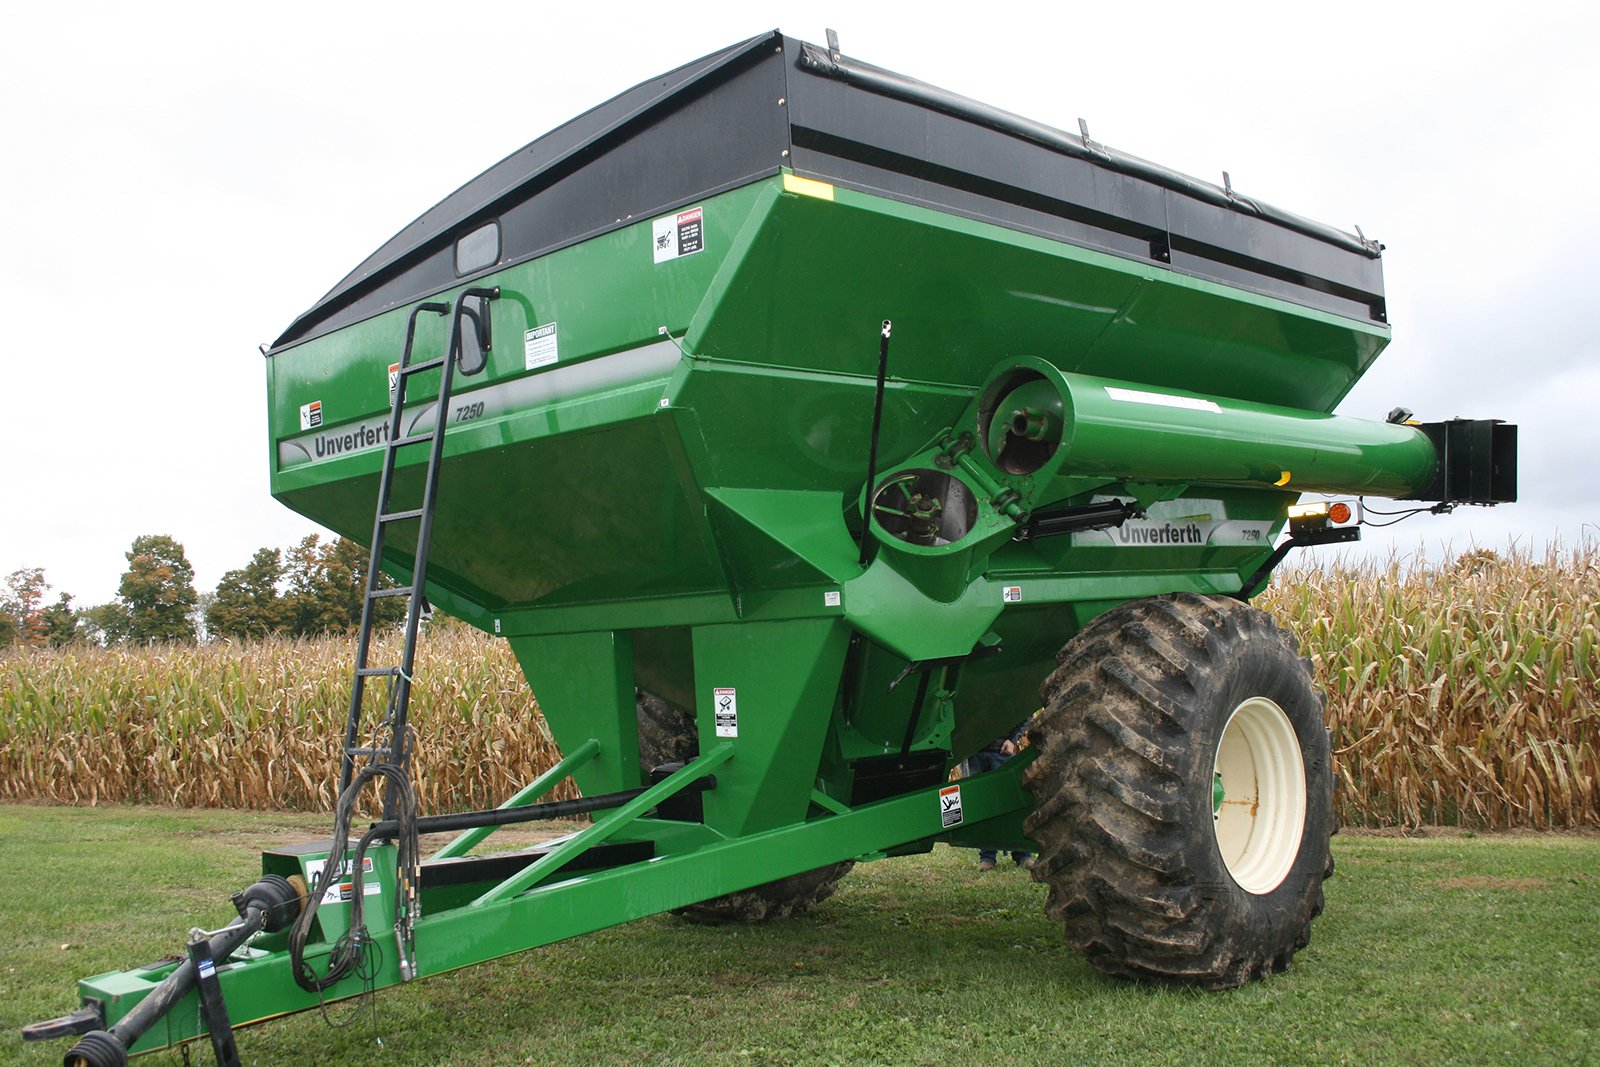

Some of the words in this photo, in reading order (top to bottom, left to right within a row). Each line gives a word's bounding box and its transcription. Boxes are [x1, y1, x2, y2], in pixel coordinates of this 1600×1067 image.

[681, 210, 701, 221] DANGER
[527, 325, 555, 341] IMPORTANT
[456, 401, 485, 422] 7250
[315, 420, 391, 458] Unverfert
[1119, 522, 1202, 544] Unverferth
